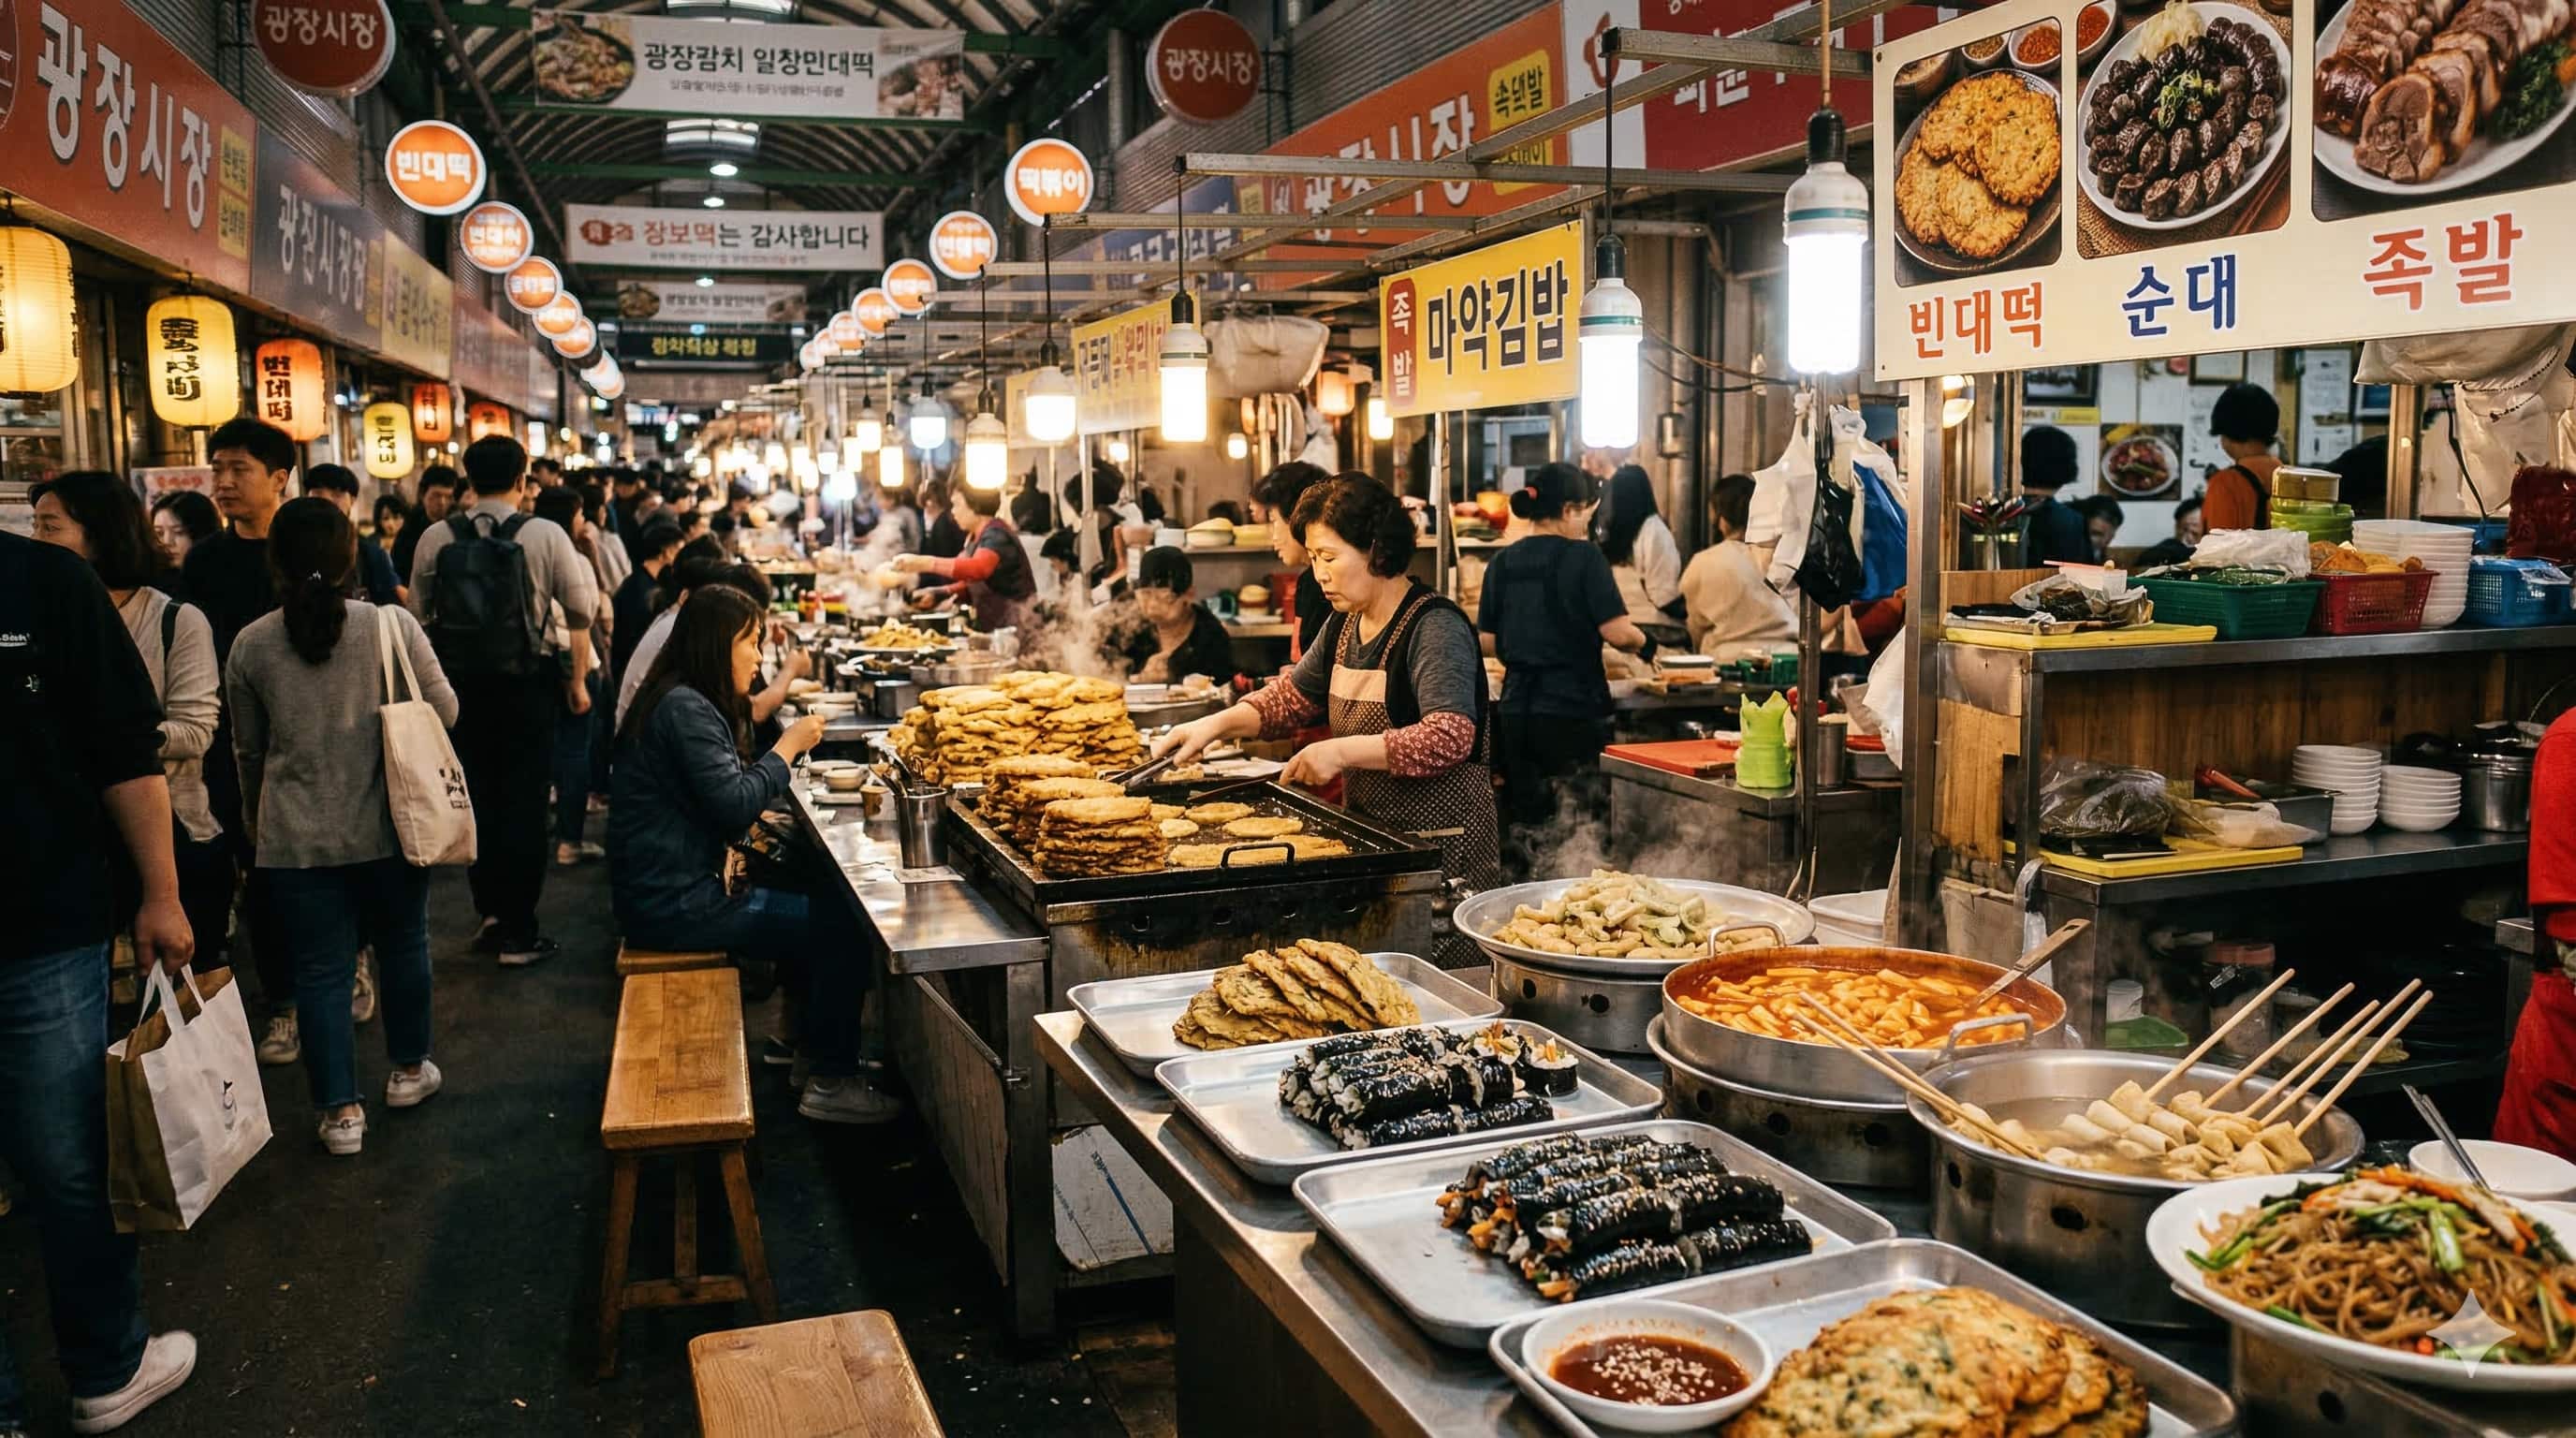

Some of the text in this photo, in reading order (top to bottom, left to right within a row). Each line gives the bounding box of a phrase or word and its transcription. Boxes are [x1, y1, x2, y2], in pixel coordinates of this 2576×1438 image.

[264, 6, 378, 50] 광장시장
[1165, 48, 1253, 85] 광장시장
[37, 2, 212, 228] 광장시장
[751, 224, 869, 249] 감사합니다
[1910, 213, 2524, 359] 빈대떡 순대 족발
[1391, 291, 1412, 397] 족발
[1427, 260, 1568, 375] 마약김밥
